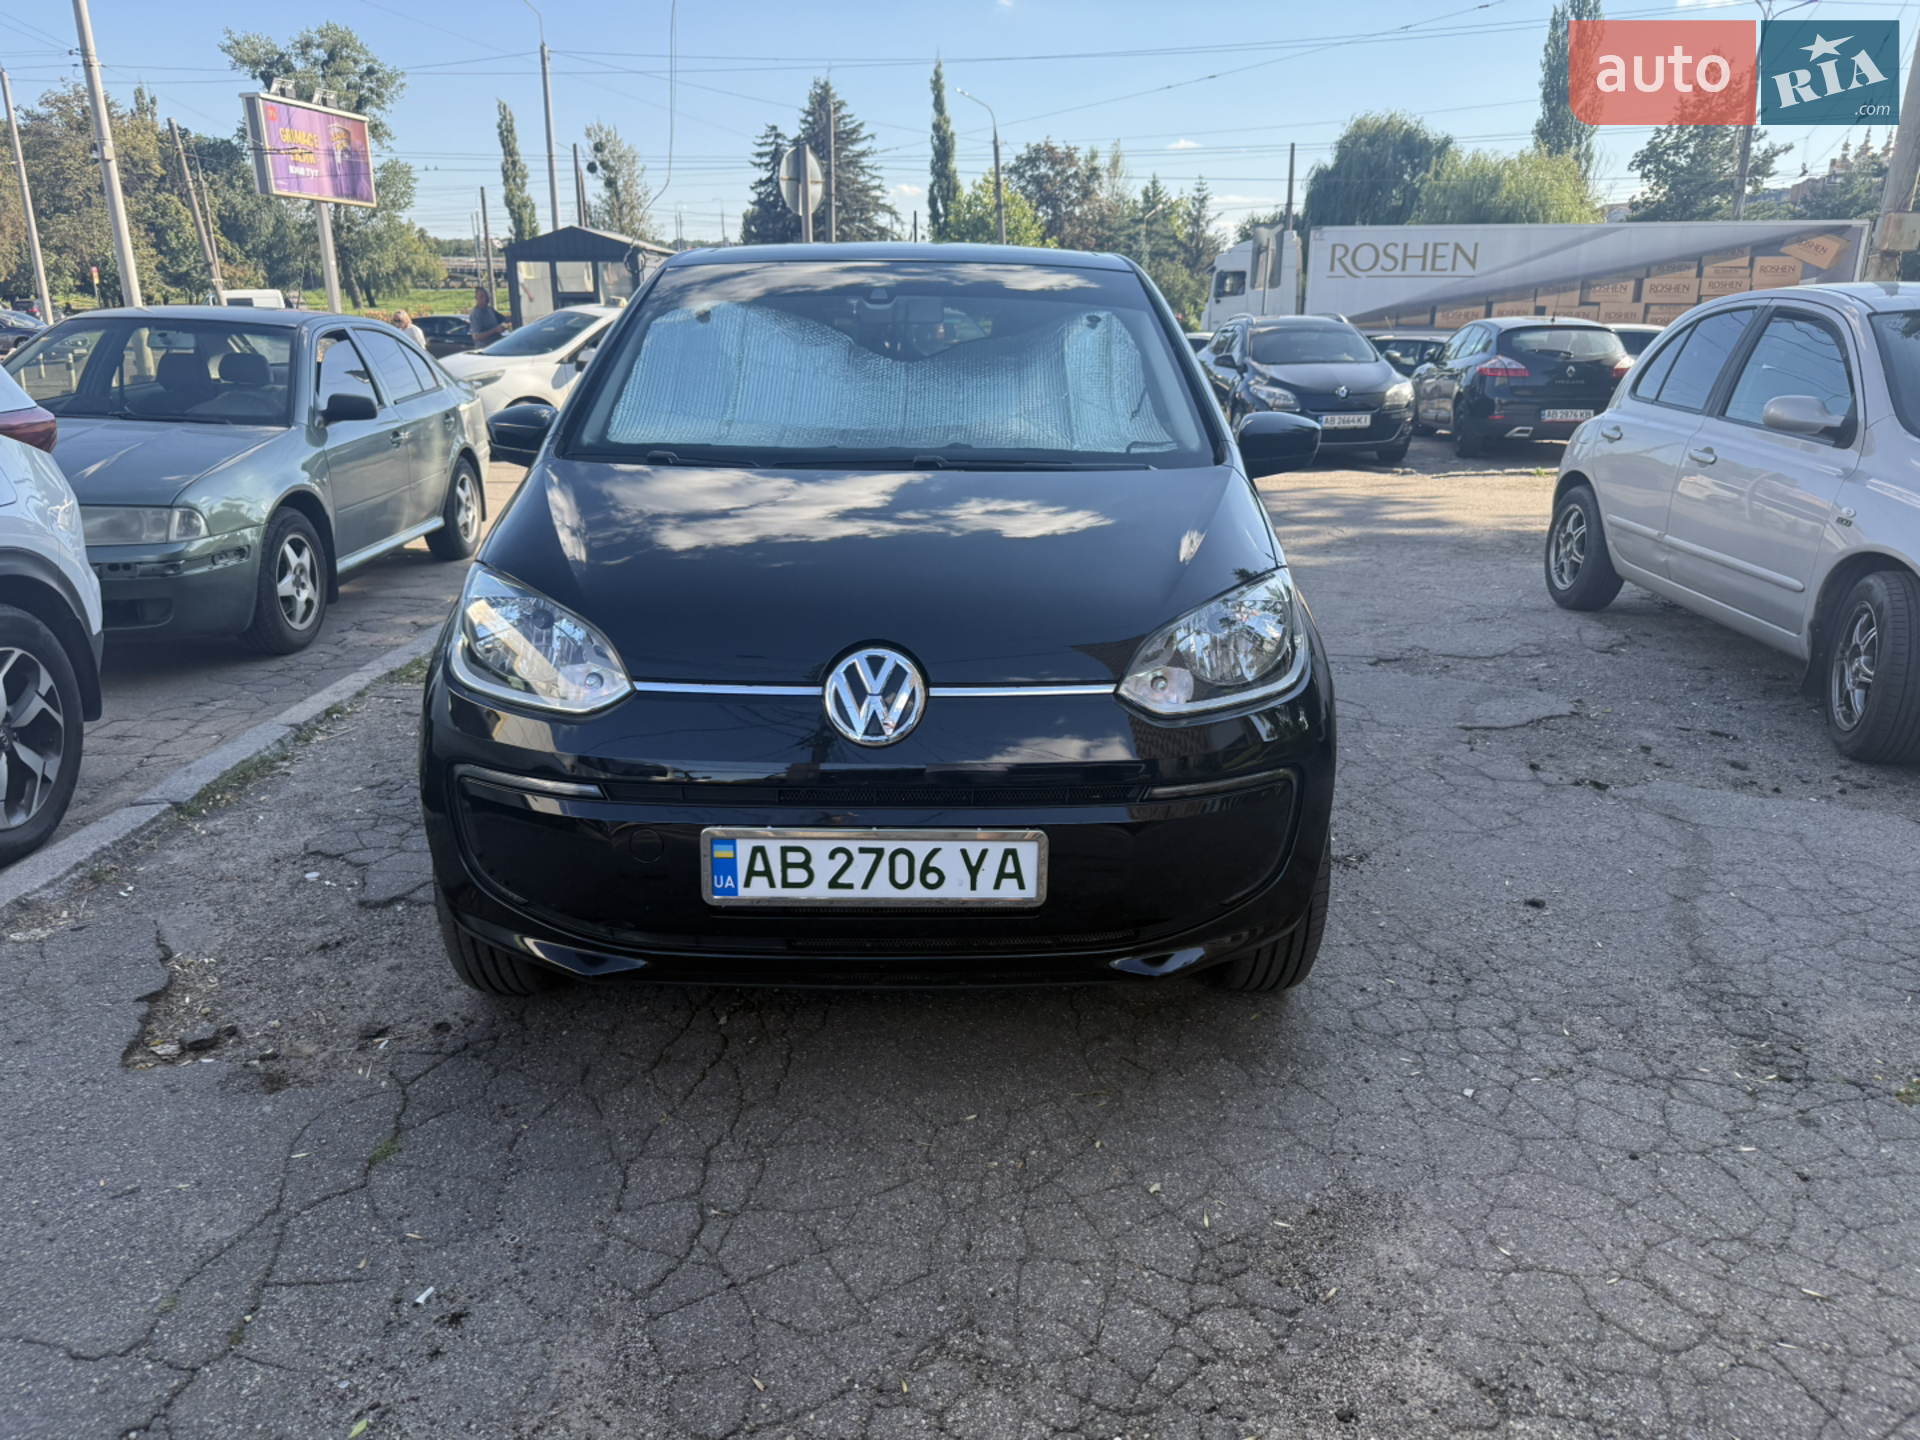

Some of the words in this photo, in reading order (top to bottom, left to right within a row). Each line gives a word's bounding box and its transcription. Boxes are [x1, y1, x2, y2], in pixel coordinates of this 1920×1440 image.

[1795, 237, 1829, 255] ROSHEN
[1329, 242, 1479, 278] ROSHEN
[1759, 264, 1797, 275] ROSHEN
[1589, 283, 1628, 293] ROSHEN
[1649, 283, 1691, 294] ROSHEN
[1708, 280, 1743, 290] ROSHEN
[1440, 310, 1479, 321] ROSHEN
[1604, 311, 1637, 320] ROSHEN
[743, 845, 816, 889] AB
[827, 846, 947, 891] 2706
[959, 847, 1027, 891] YA
[714, 875, 736, 888] UA
